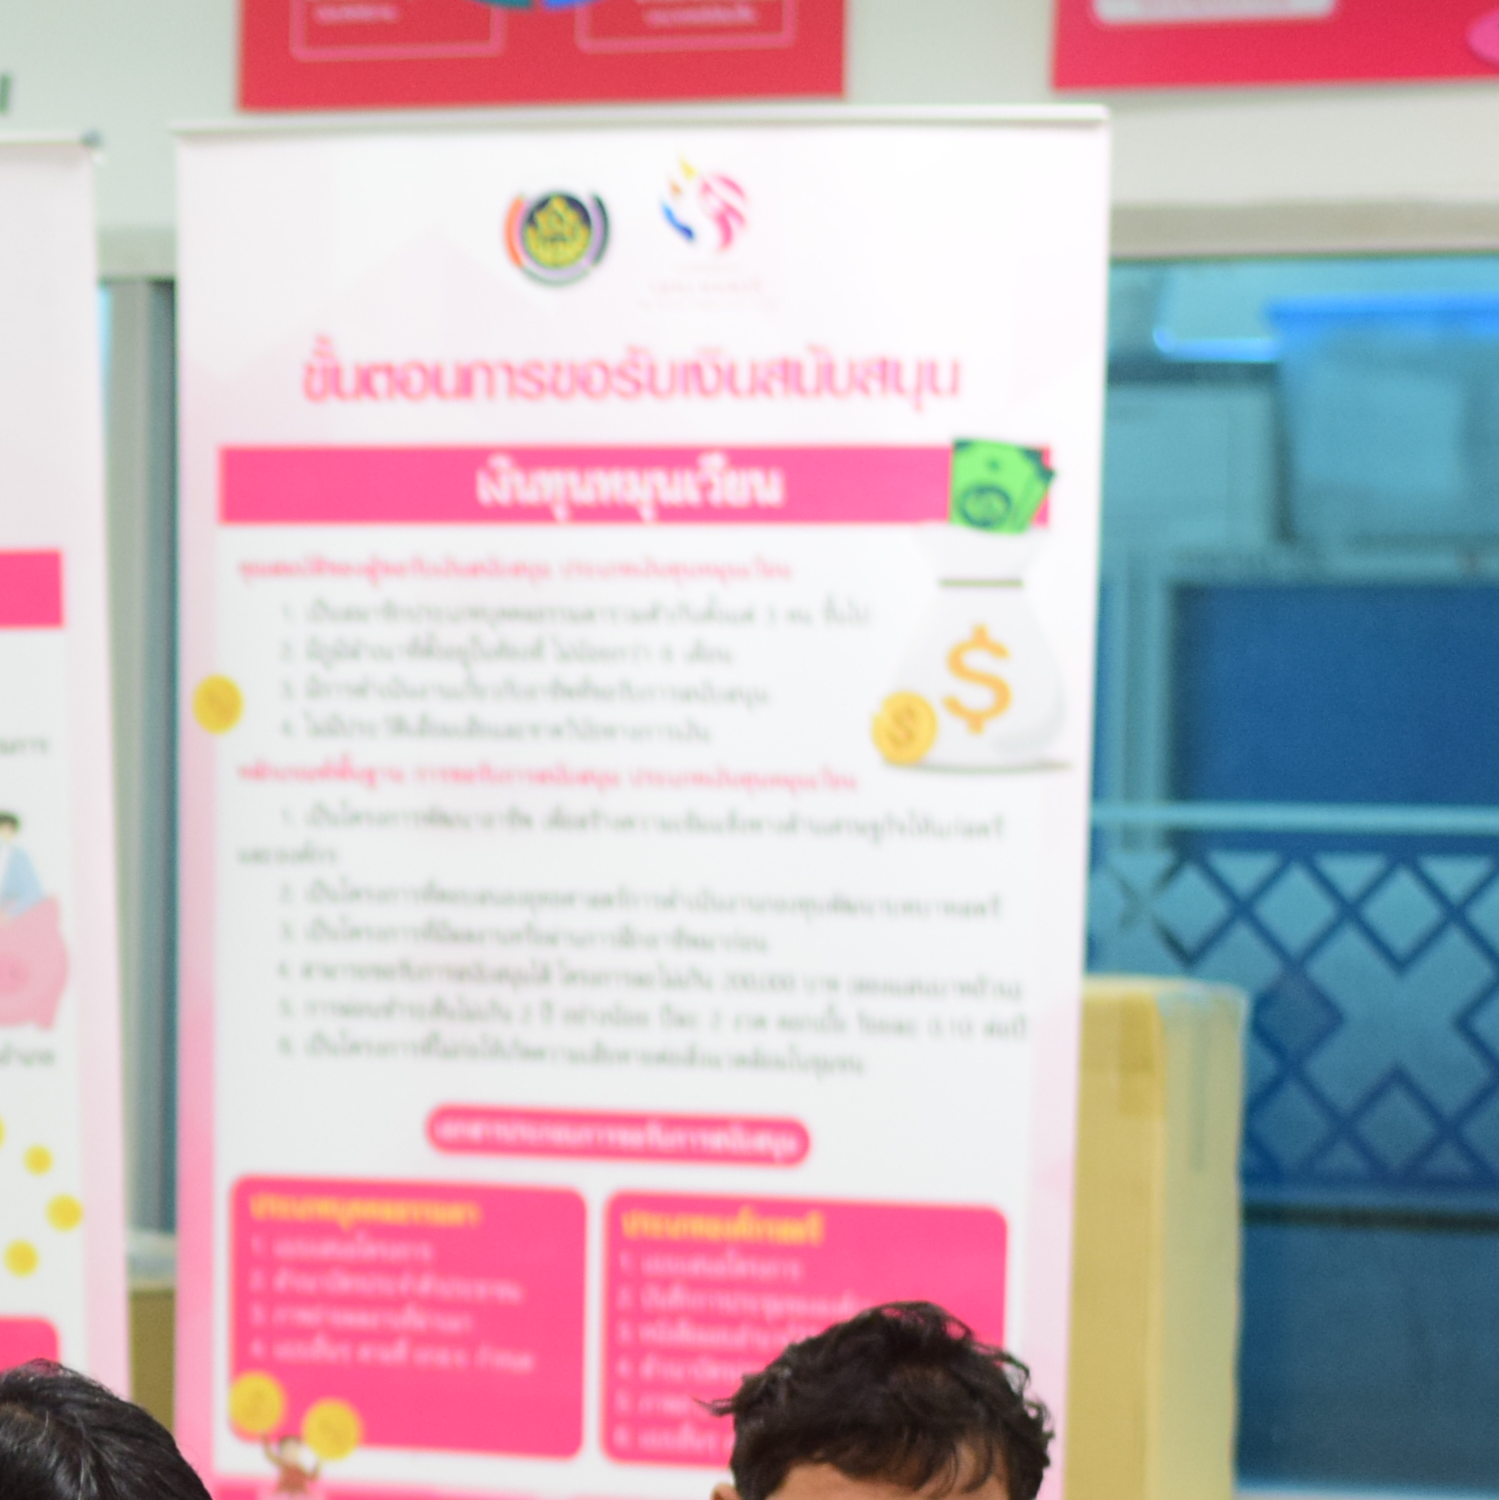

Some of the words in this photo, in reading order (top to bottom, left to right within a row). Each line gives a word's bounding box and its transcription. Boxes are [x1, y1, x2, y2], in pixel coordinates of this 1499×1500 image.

[301, 335, 960, 411] ขั้นตอนการขอรับเงินสนับสนุน
[477, 452, 783, 523] เงินทุนหมุนเวียน
